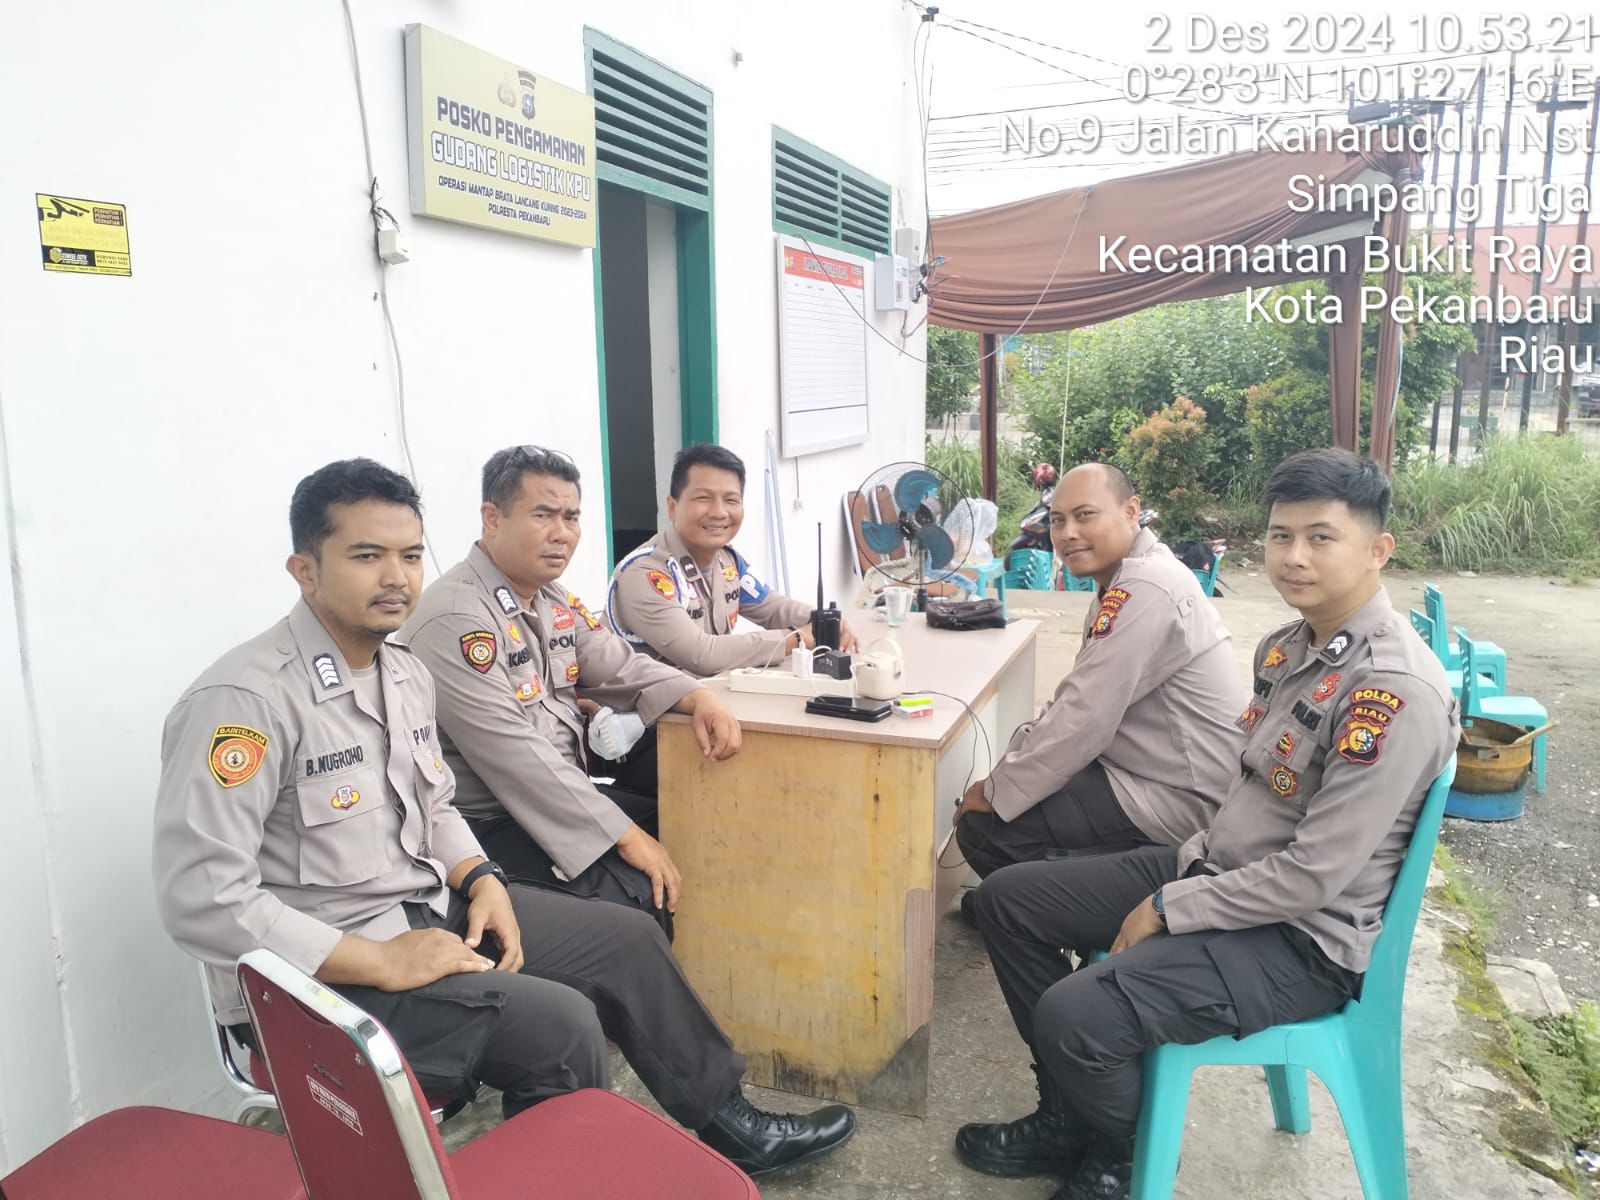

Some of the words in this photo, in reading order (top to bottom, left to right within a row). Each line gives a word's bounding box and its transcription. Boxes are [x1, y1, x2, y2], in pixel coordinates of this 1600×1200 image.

[437, 96, 491, 137] POSKO
[495, 116, 585, 166] PENGAMANAN
[431, 131, 497, 177] GUDANG
[500, 152, 564, 195] LOGISTIK
[566, 171, 591, 202] KPU
[438, 175, 467, 193] OPERASI
[468, 183, 494, 199] MANTAP
[495, 190, 514, 204] BRATA
[514, 195, 540, 209] LANCANG
[488, 203, 517, 219] POLRESTA
[518, 210, 551, 226] PEKANBARU
[549, 635, 576, 651] POL
[1355, 690, 1399, 709] POLDA
[1355, 707, 1388, 721] RIAU
[219, 727, 265, 745] BAINTELKAM
[306, 744, 364, 777] B.NUGROHO
